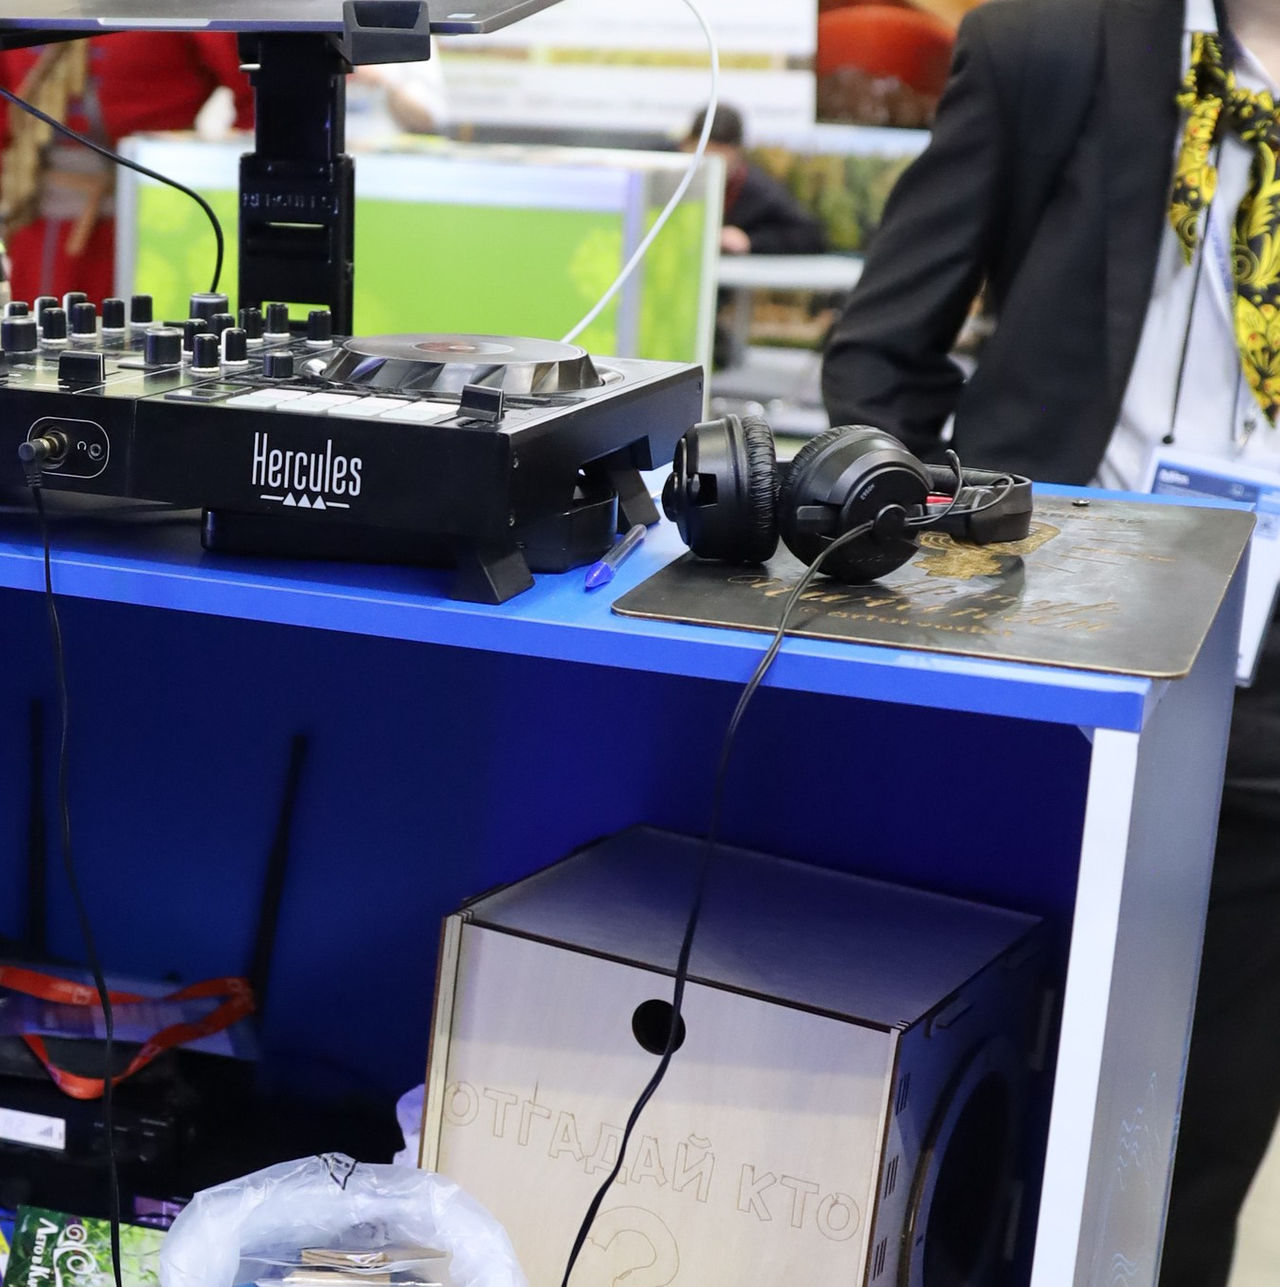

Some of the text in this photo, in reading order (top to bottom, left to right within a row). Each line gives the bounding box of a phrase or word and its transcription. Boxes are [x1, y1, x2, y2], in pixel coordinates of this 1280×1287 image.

[251, 431, 363, 497] Hercules
[442, 1080, 861, 1242] ОТГАДАЙ КТО
